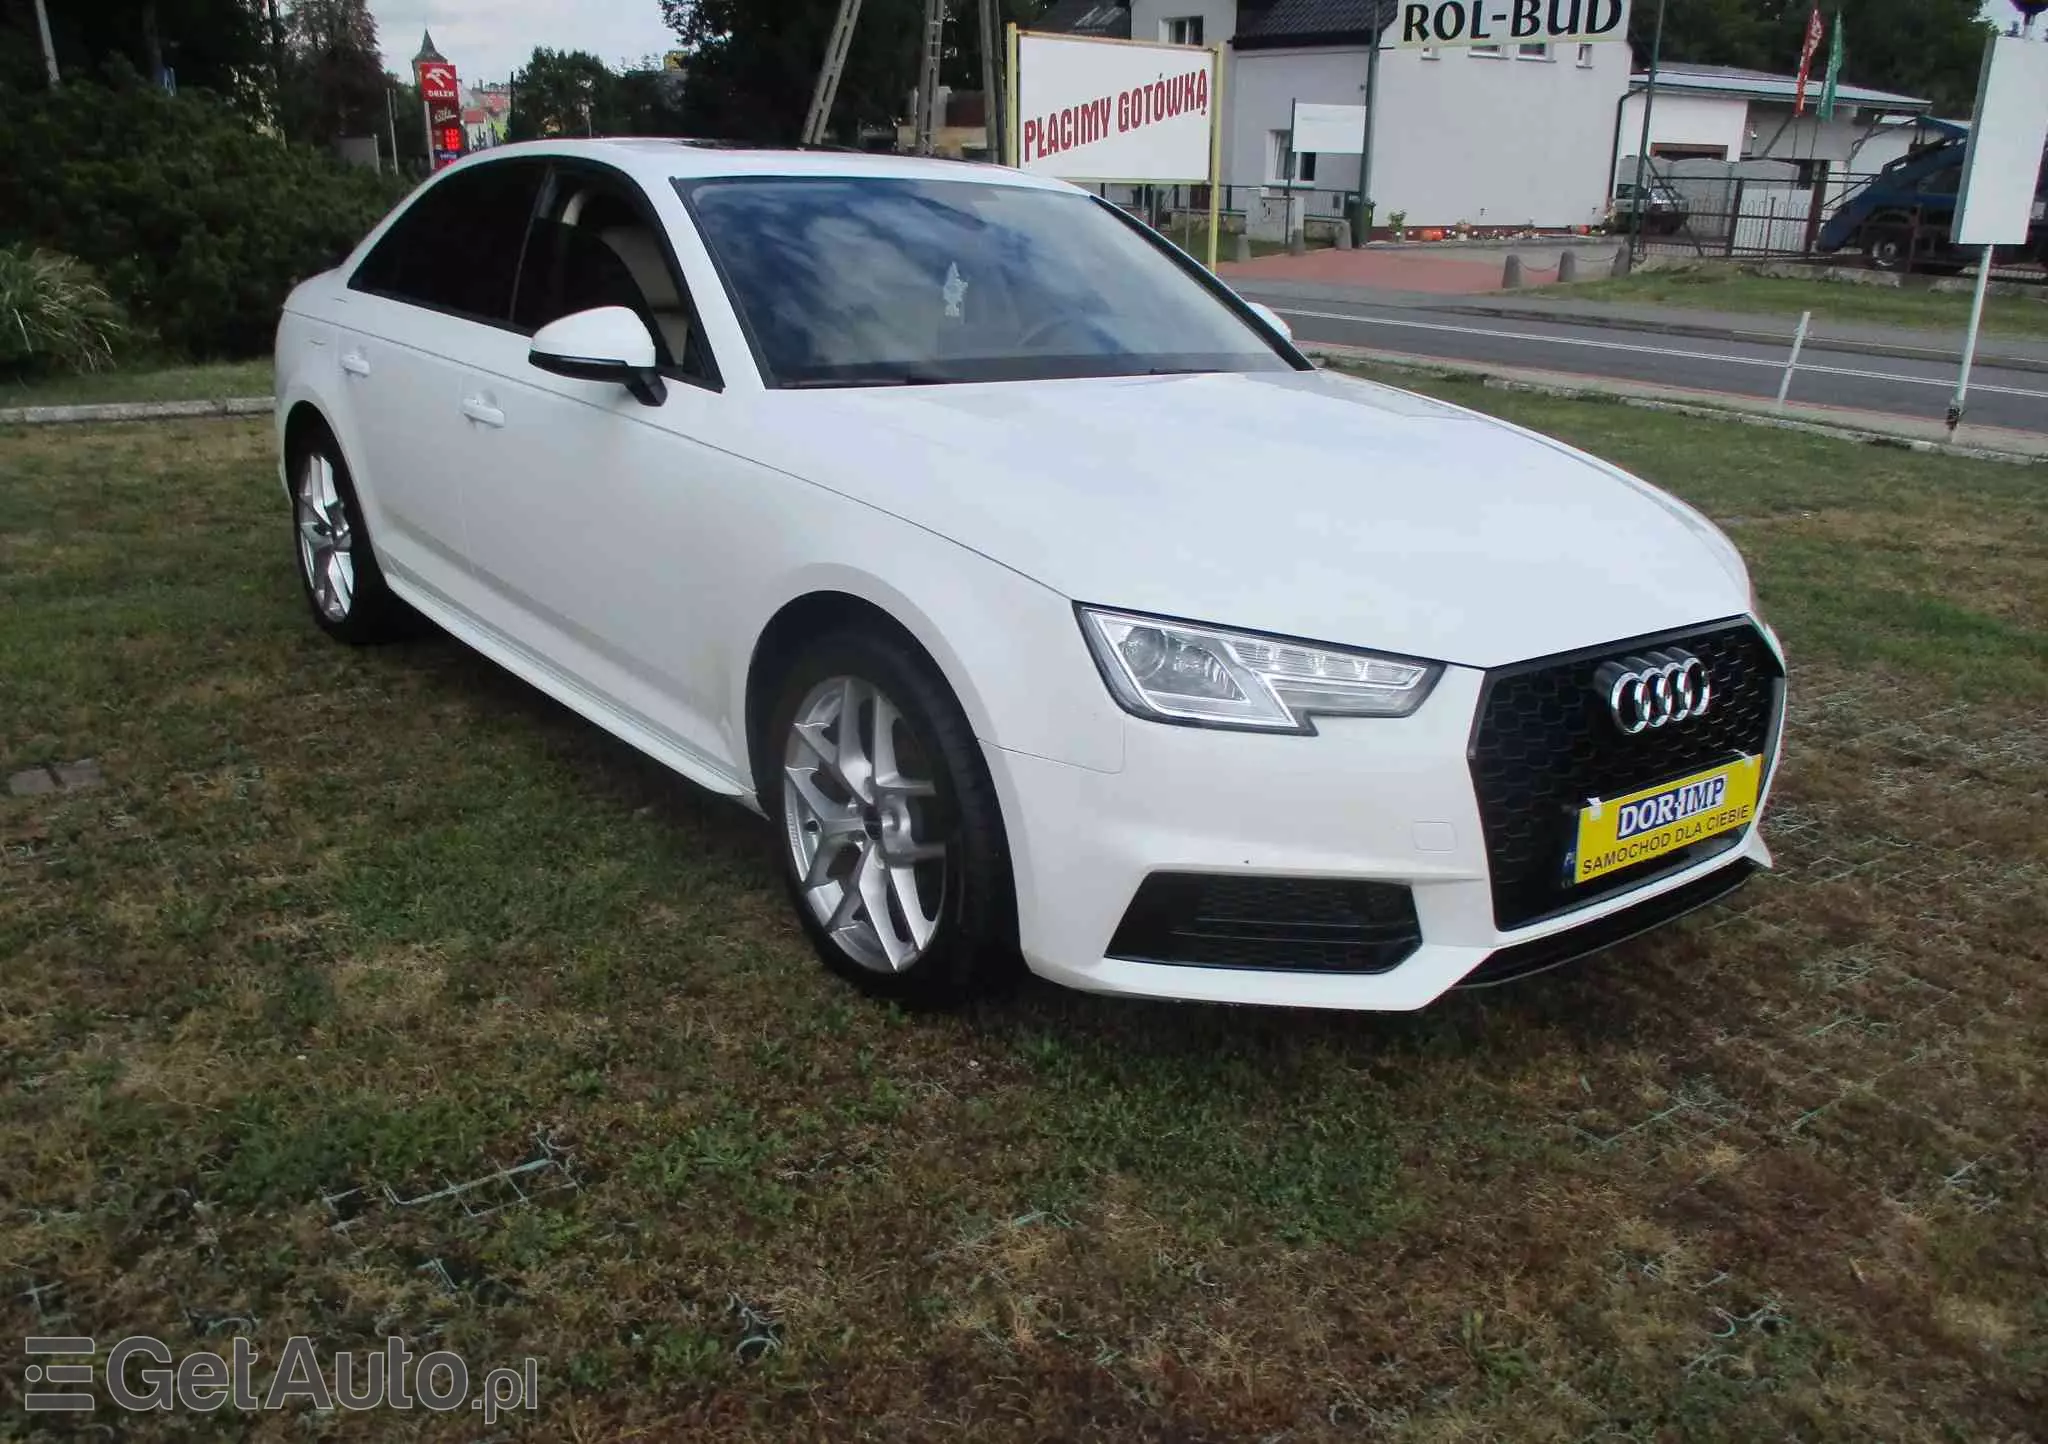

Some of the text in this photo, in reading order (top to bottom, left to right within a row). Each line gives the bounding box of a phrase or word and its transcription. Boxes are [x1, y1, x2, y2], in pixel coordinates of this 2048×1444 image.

[1403, 0, 1622, 42] ROL-BUD
[1024, 68, 1208, 162] PŁACIMY GOTÓWKĄ
[1675, 821, 1703, 843] DLA
[1706, 804, 1750, 831] CIEBIE
